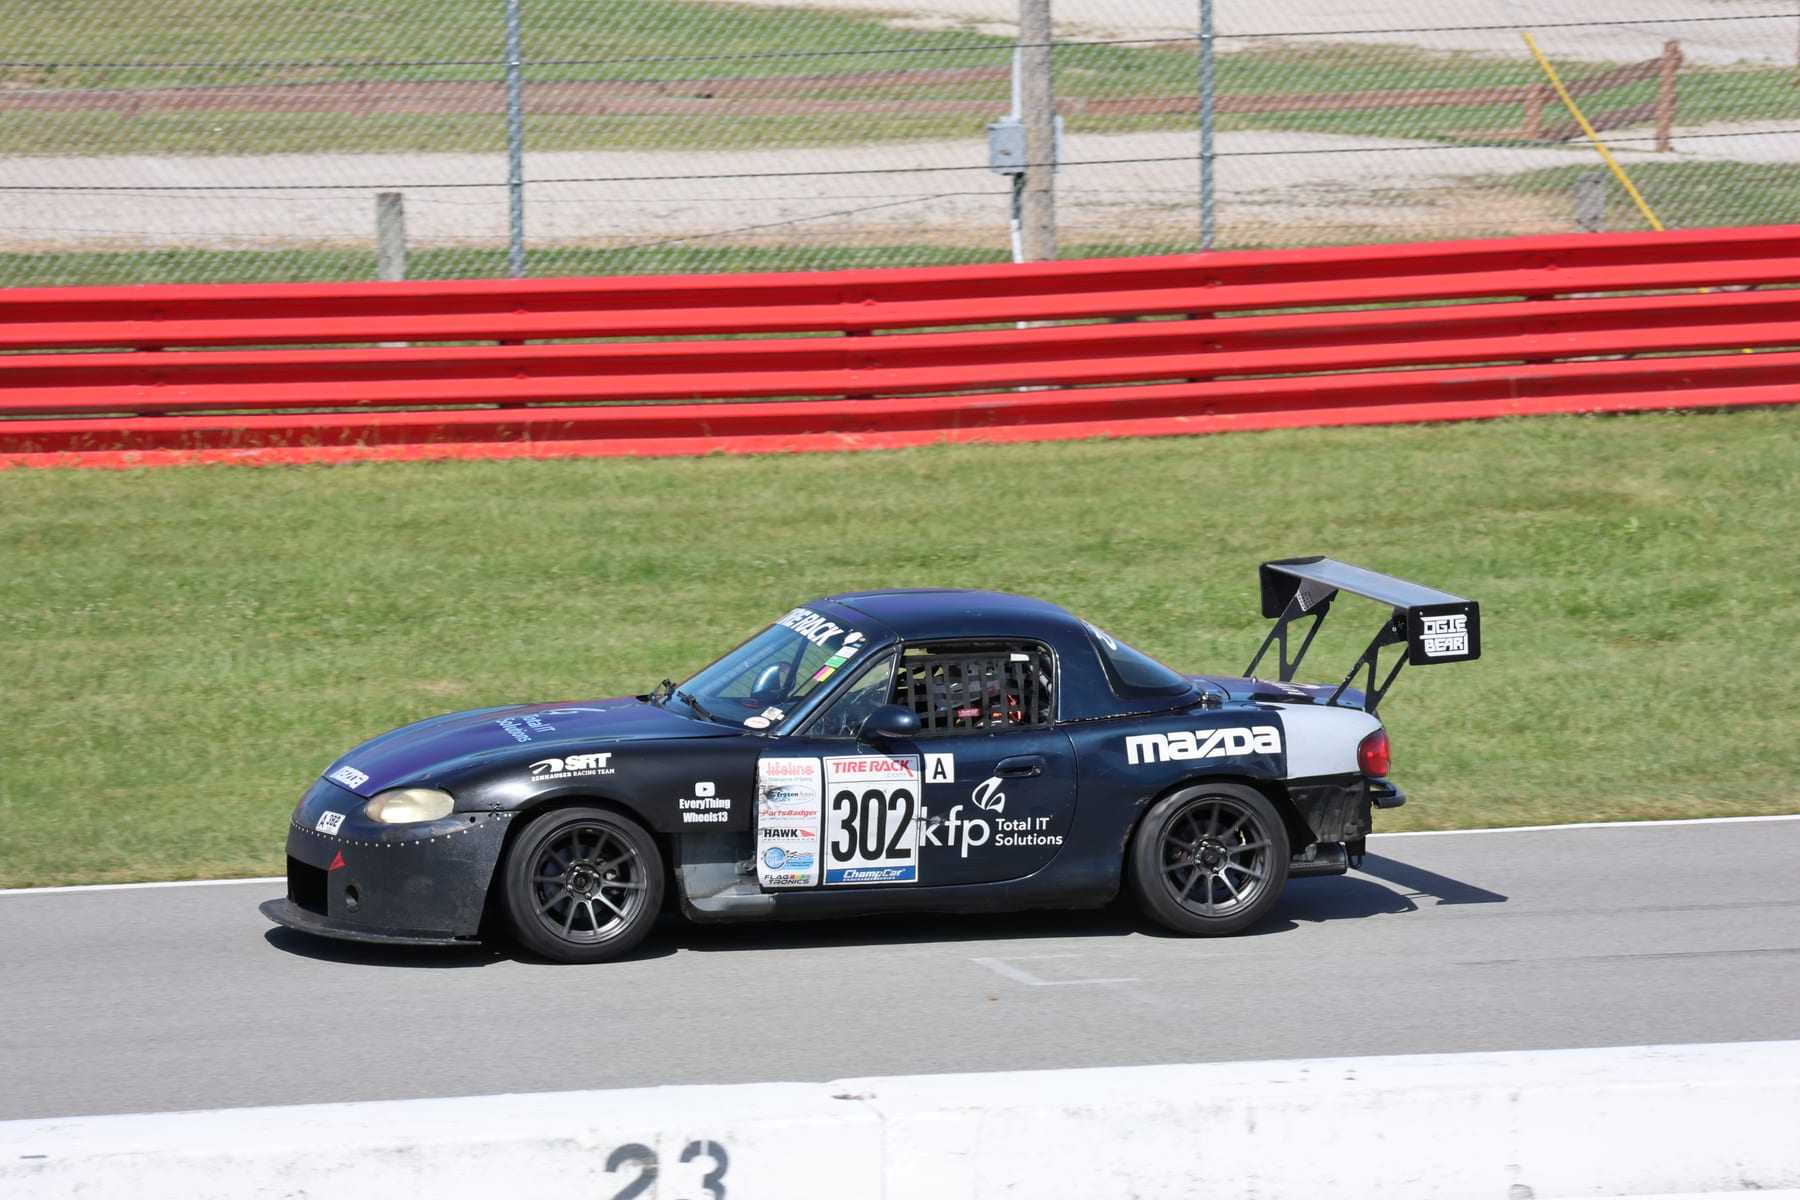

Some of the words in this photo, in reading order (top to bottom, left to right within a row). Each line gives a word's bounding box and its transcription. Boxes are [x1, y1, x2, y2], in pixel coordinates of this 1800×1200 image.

[789, 612, 845, 647] RACK
[1420, 634, 1468, 657] BEAR
[565, 752, 612, 771] SRT
[832, 761, 868, 774] TIRE
[869, 760, 914, 777] RACK
[932, 757, 947, 780] A
[679, 798, 731, 809] EveryThing
[683, 811, 728, 823] Wheels13
[831, 788, 915, 862] 302
[995, 816, 1031, 831] Total
[1036, 817, 1050, 830] IT
[764, 828, 799, 838] HAWK
[919, 804, 990, 858] kfp
[995, 833, 1063, 846] Solutions
[843, 867, 903, 881] ChampCar
